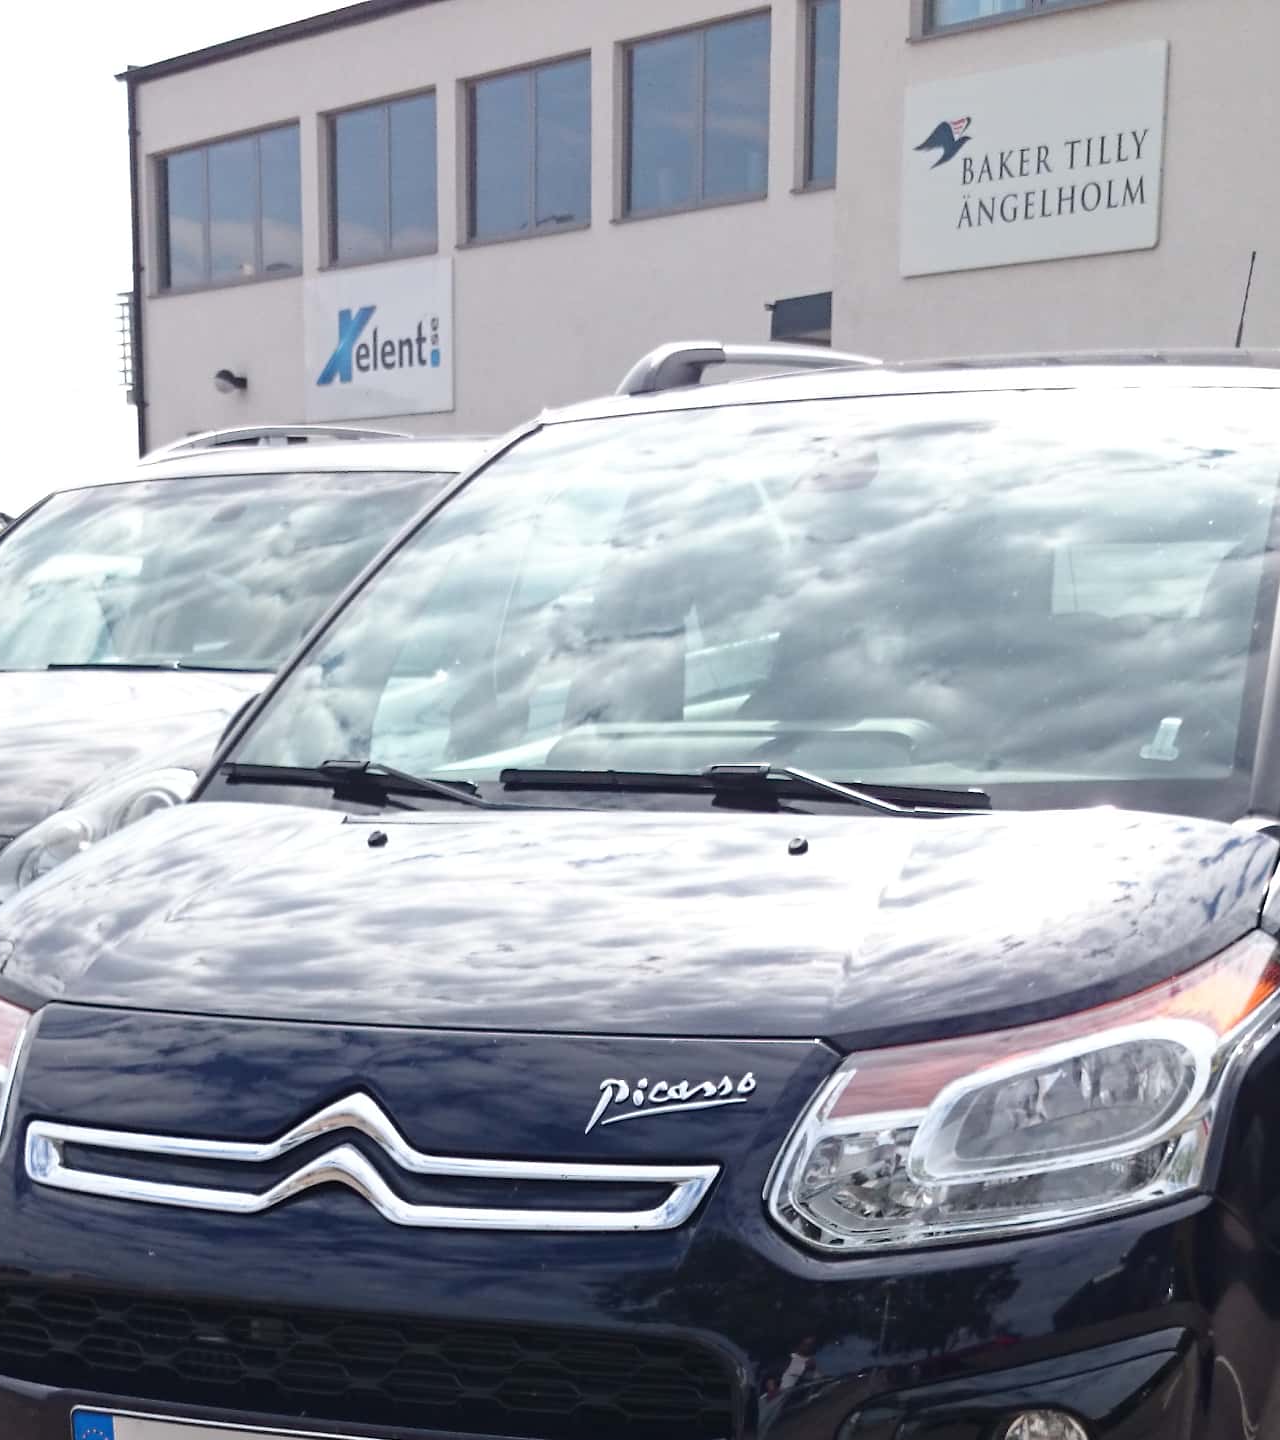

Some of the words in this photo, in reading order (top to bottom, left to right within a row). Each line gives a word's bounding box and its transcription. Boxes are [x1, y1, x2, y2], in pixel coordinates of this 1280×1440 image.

[960, 144, 1052, 186] BAKER
[1065, 128, 1150, 171] TILLY
[956, 175, 1146, 229] ÄNGELHOLM
[317, 305, 427, 387] Xelent
